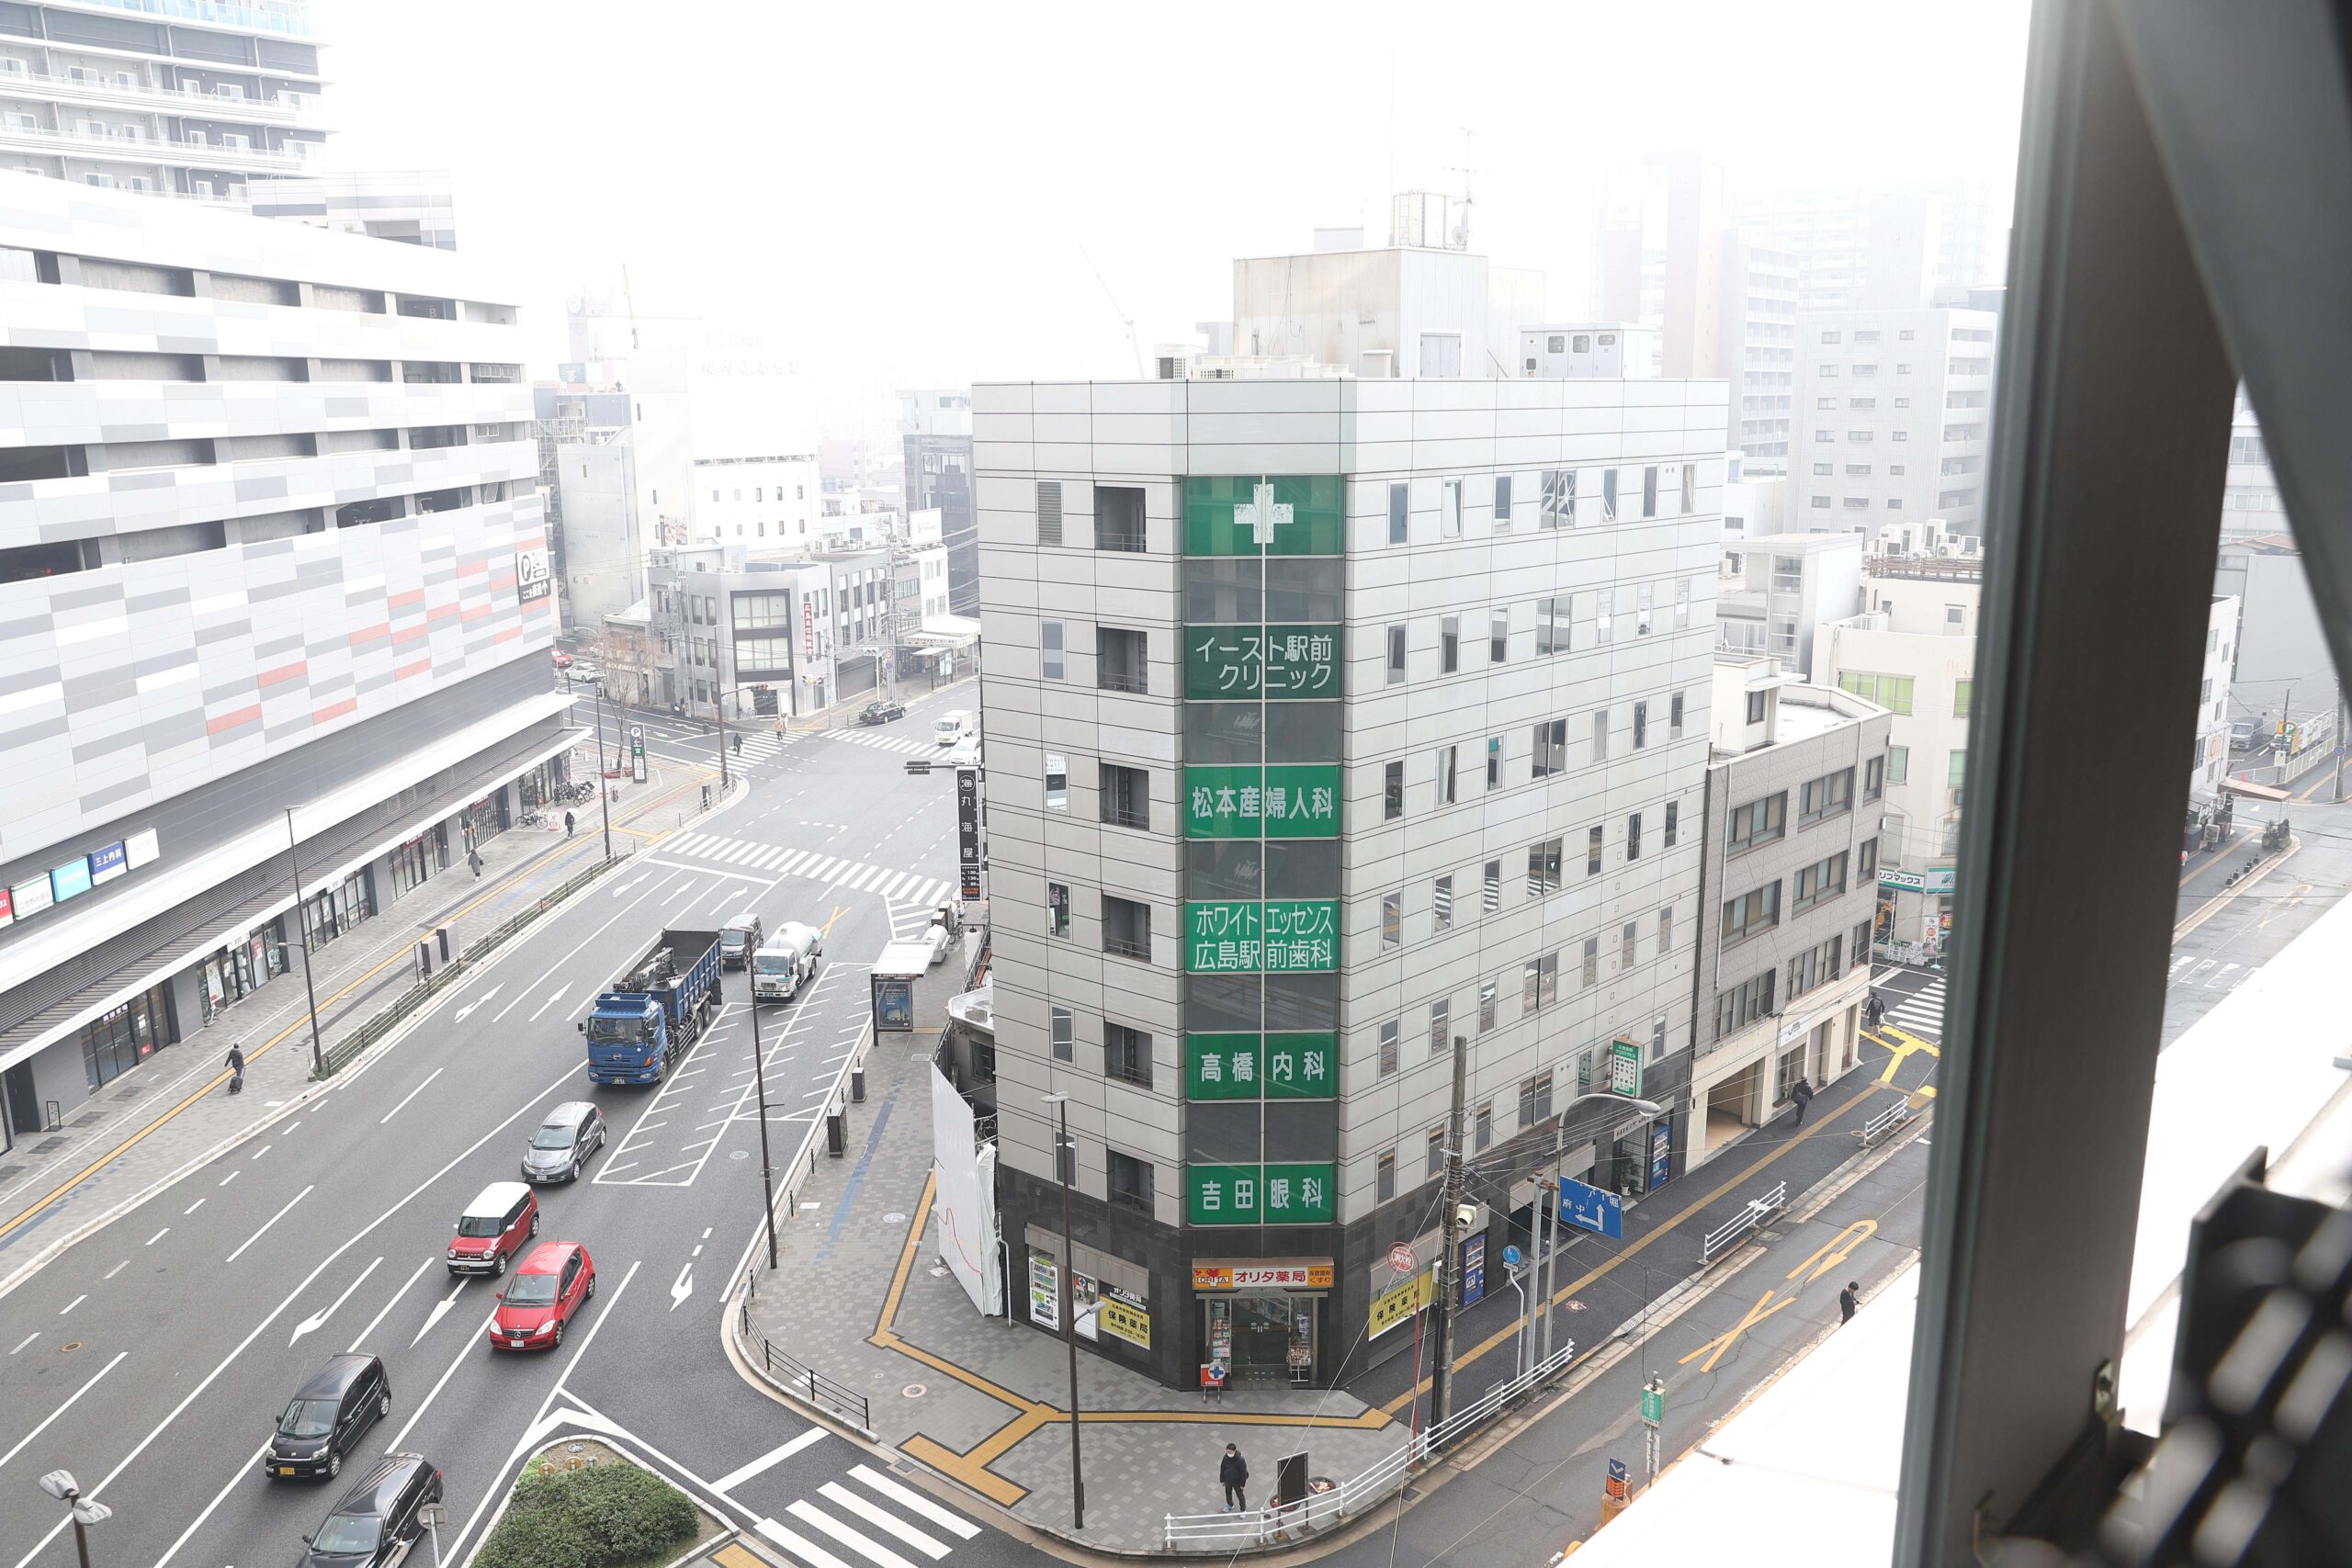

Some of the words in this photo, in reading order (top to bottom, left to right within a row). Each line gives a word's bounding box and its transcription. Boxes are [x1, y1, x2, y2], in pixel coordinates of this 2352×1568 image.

[1195, 634, 1333, 662] イースト駅前
[1218, 662, 1332, 691] クリニック
[1192, 784, 1333, 820] 松本産婦人科
[1194, 939, 1333, 970] 広島駅前歯科
[1201, 1050, 1325, 1083] 高橋内科
[1201, 1177, 1323, 1211] 吉田眼科
[1235, 1270, 1306, 1283] オリタ薬局
[1108, 1309, 1148, 1334] 保険薬局
